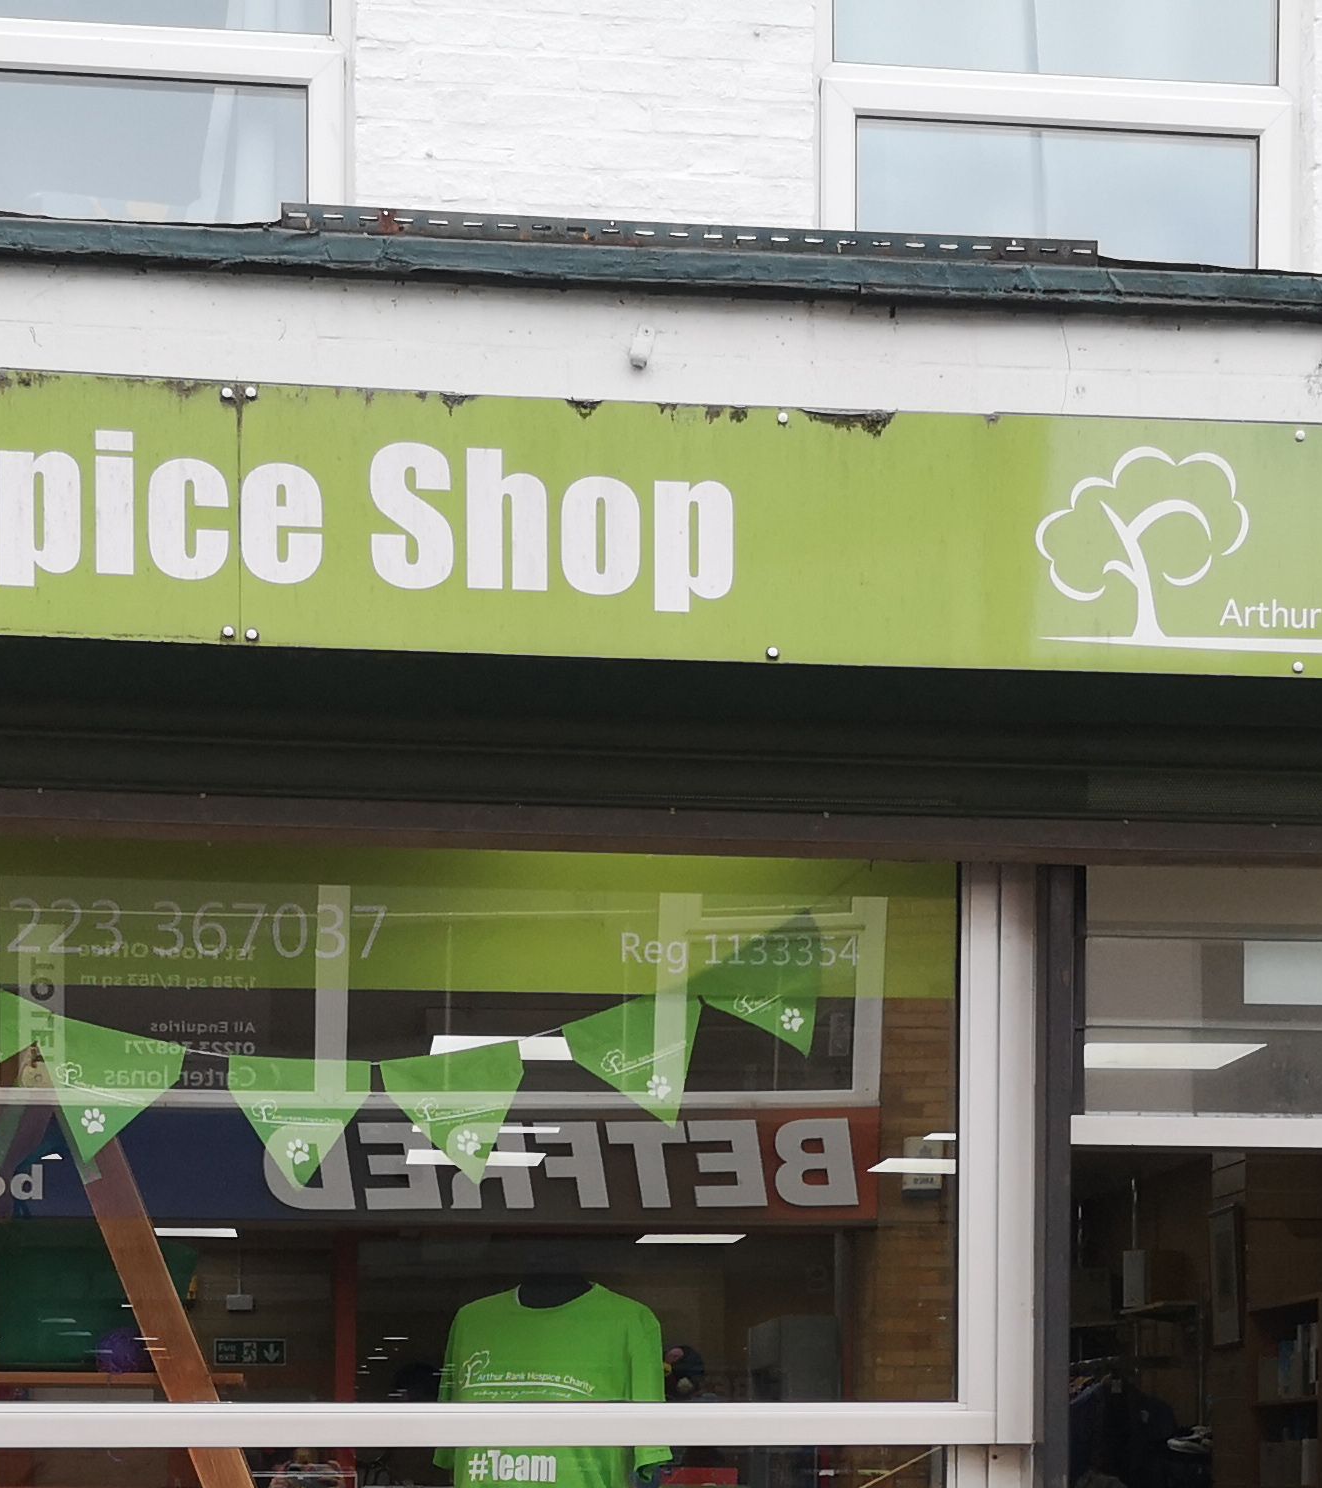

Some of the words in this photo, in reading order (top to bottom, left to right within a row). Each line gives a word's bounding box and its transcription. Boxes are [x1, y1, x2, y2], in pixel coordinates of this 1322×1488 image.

[369, 441, 735, 612] Shop
[1219, 597, 1321, 630] Arthur
[152, 901, 388, 960] 367037
[621, 931, 689, 974] Reg
[704, 933, 861, 968] 1133354
[478, 1372, 504, 1382] Arthur
[506, 1371, 526, 1381] Rank
[527, 1372, 561, 1383] Hospice
[563, 1375, 595, 1393] Charity
[468, 1449, 557, 1483] #Team
